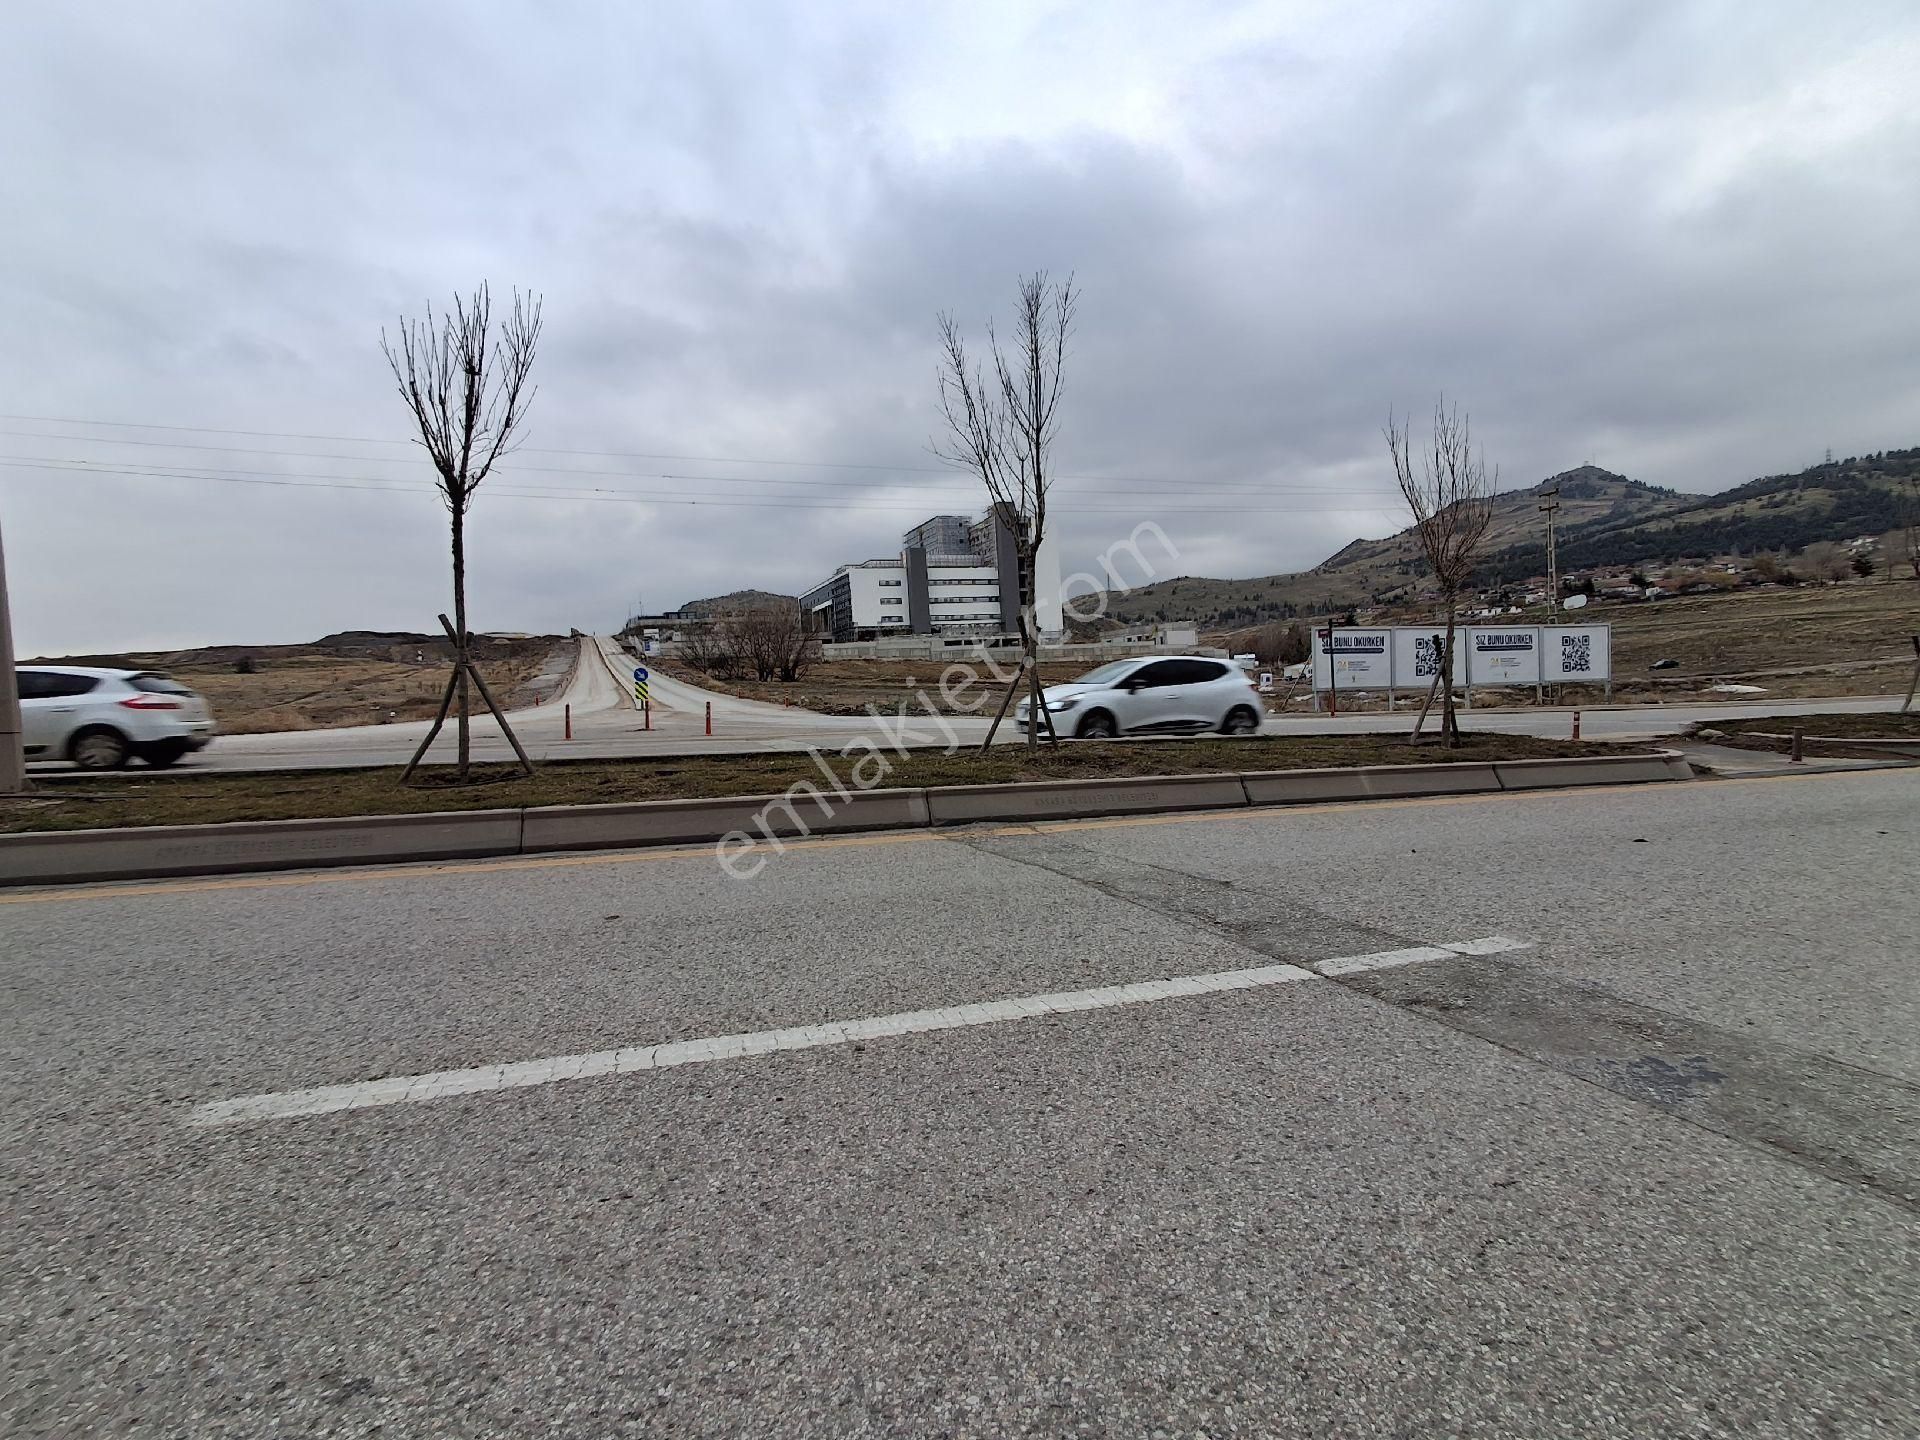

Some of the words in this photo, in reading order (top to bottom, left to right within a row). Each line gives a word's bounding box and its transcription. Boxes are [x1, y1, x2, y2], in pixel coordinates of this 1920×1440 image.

[1353, 636, 1385, 647] OKURKEN
[1487, 634, 1504, 645] BUNU
[1505, 634, 1533, 645] OKURKEN
